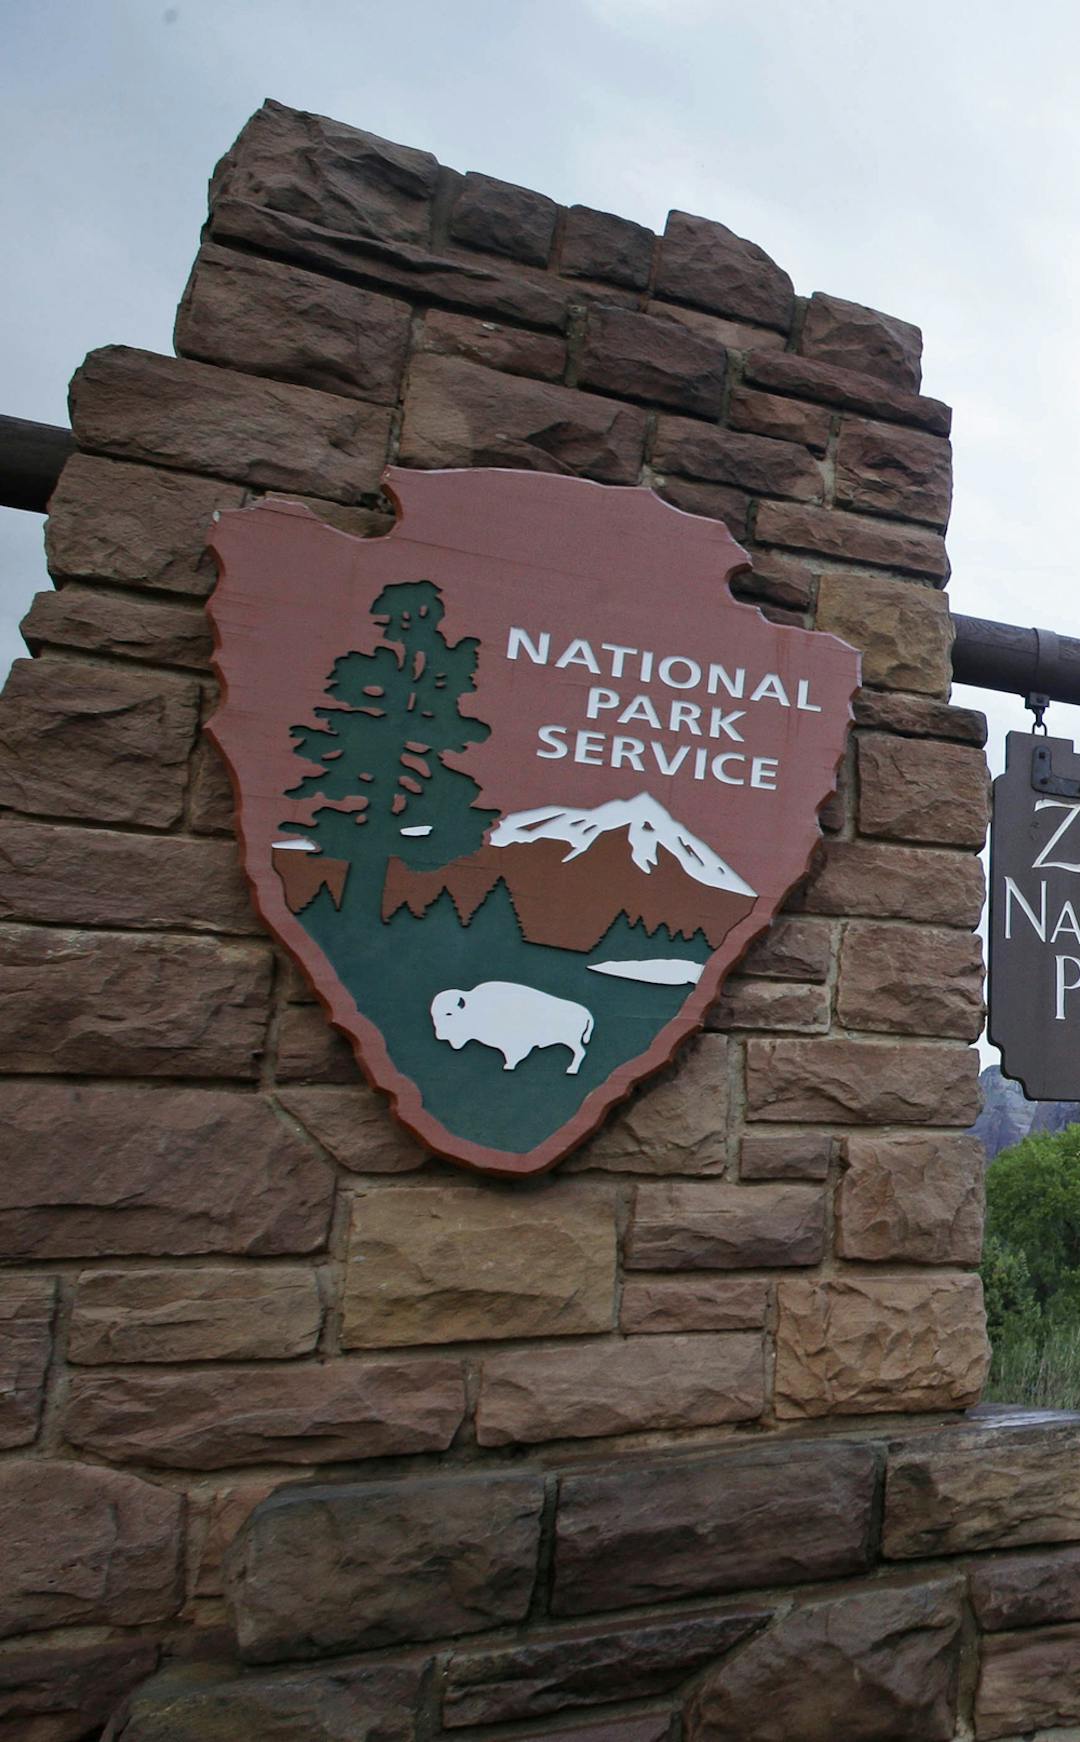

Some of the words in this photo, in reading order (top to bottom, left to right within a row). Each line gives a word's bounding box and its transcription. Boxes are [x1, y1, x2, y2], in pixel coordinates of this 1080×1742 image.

[506, 626, 823, 713] NATIONAL
[586, 686, 746, 742] PARK
[535, 724, 780, 790] SERVICE
